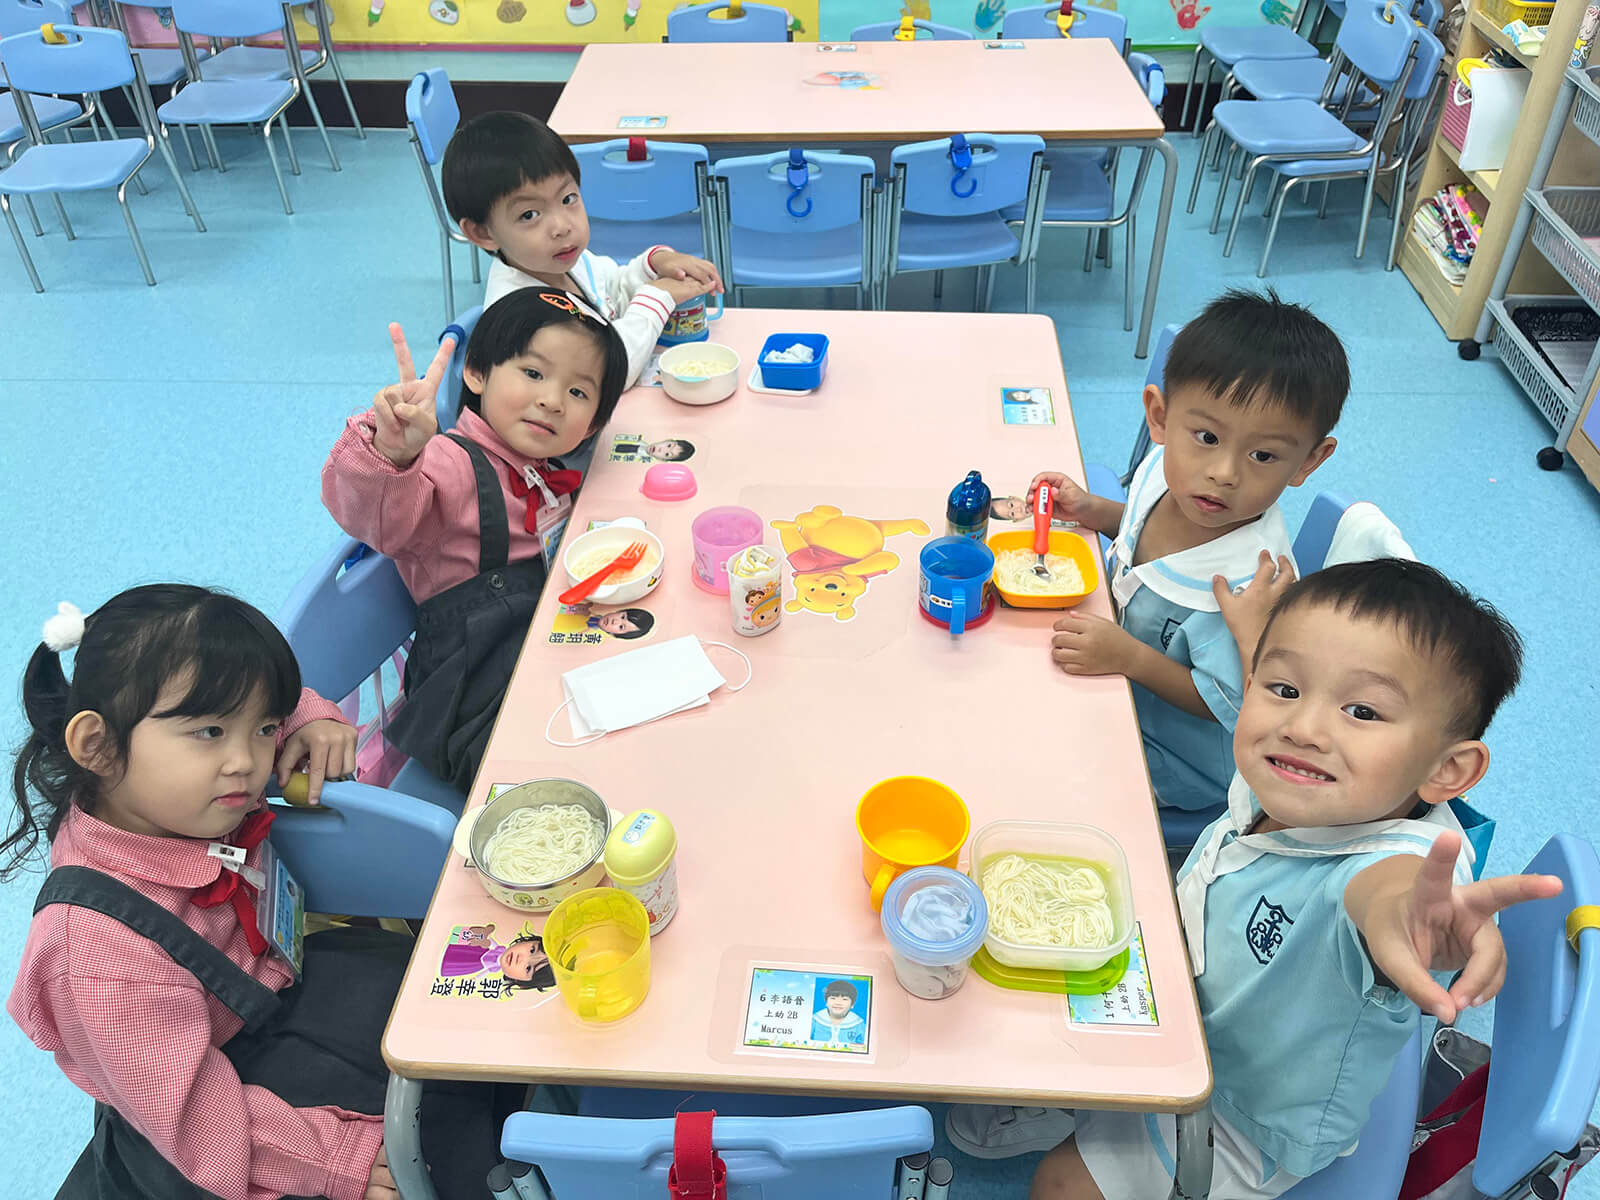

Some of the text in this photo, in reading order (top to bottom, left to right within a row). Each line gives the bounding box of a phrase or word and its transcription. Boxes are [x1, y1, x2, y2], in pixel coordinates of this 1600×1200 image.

[430, 977, 503, 998] 郭幸澄
[759, 993, 767, 1002] 6
[1117, 982, 1131, 1013] 上幼 2B
[1137, 987, 1148, 1016] Kasper
[764, 1009, 799, 1020] 上幼 2B
[760, 1024, 793, 1035] Marcus
